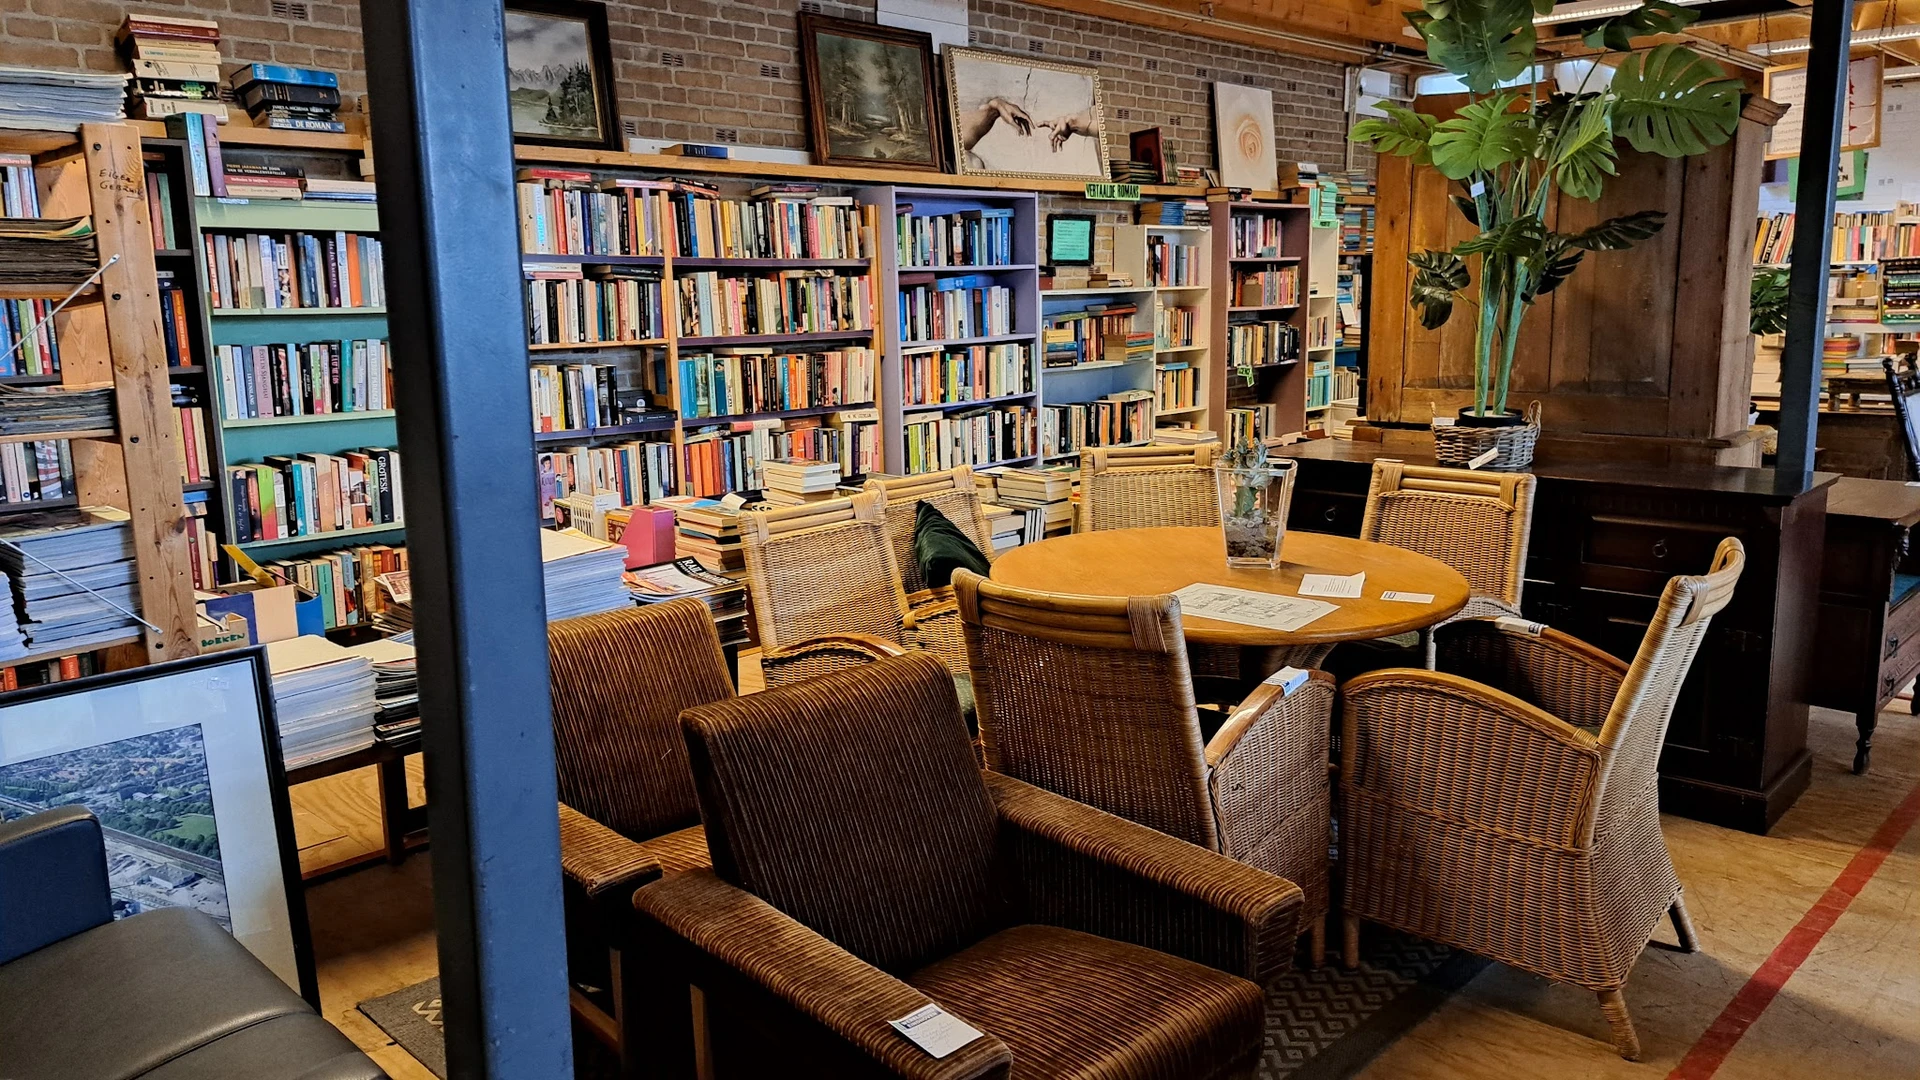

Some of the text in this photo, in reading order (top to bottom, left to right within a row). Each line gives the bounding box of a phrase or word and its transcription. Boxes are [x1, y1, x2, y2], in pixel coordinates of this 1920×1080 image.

[295, 120, 305, 128] DE
[305, 121, 331, 130] ROMAN
[1085, 183, 1139, 199] VERTAALDE ROMANS
[378, 456, 388, 493] GROTESK
[681, 558, 703, 573] RAIL
[201, 632, 245, 647] BOEKEN
